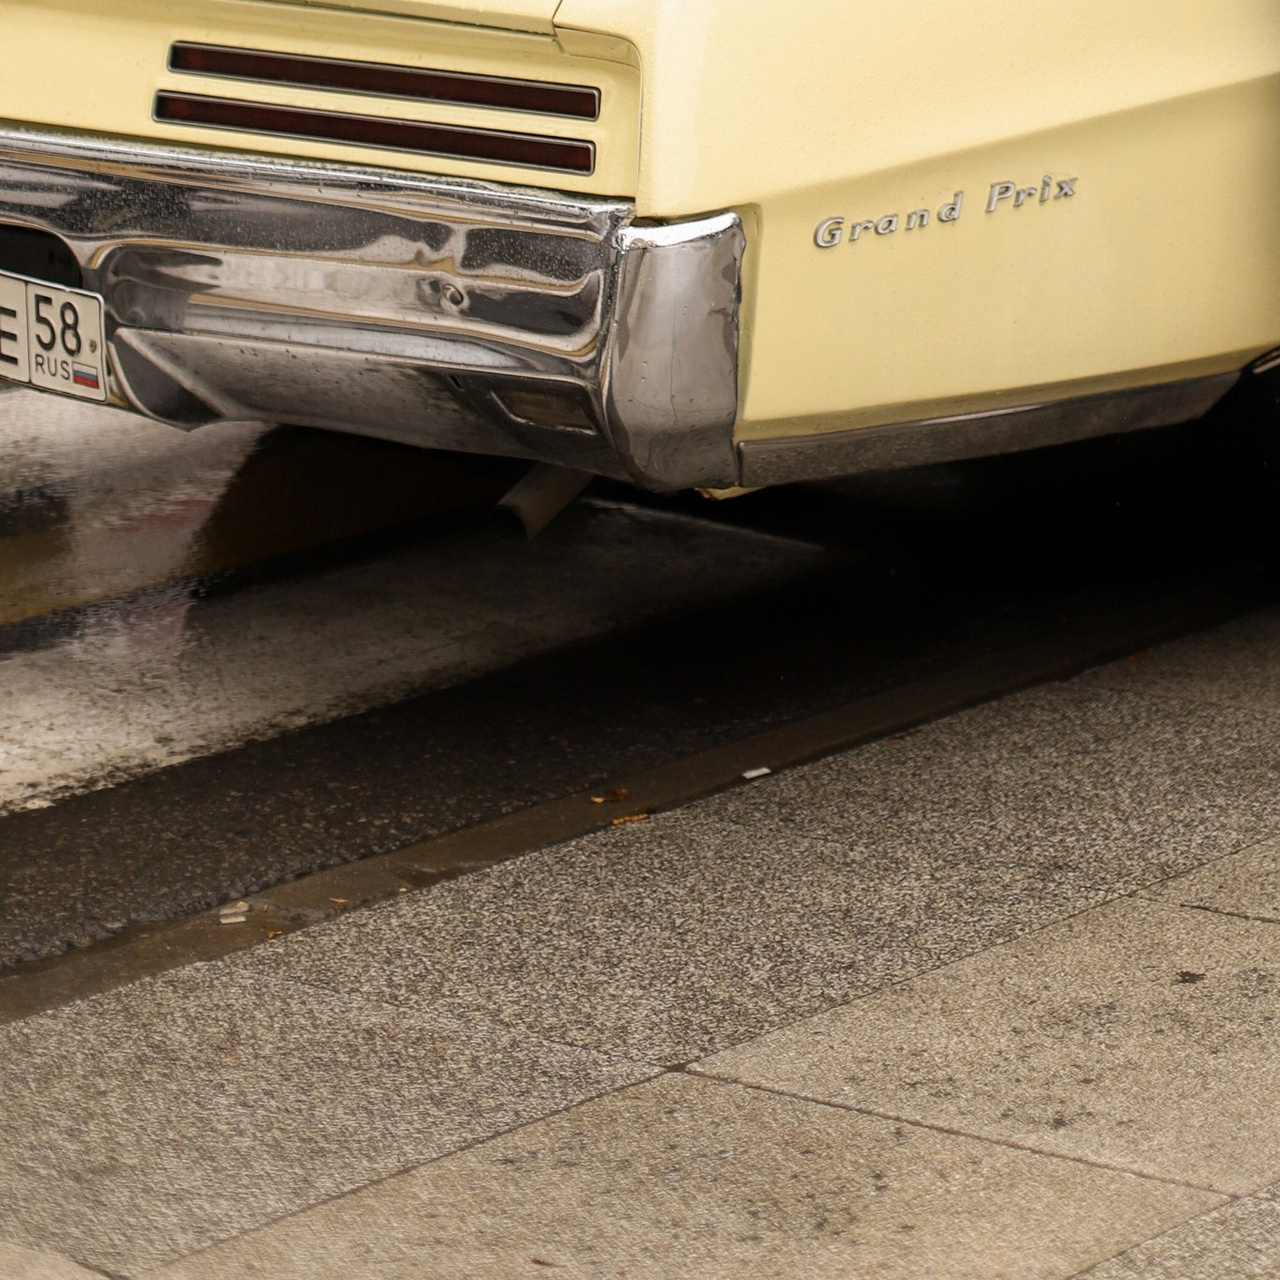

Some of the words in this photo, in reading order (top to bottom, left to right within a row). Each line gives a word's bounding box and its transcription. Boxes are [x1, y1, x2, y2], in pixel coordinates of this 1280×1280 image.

[813, 190, 964, 248] Grand
[984, 175, 1079, 213] Prix
[34, 293, 82, 358] 58
[34, 353, 71, 381] RUS
